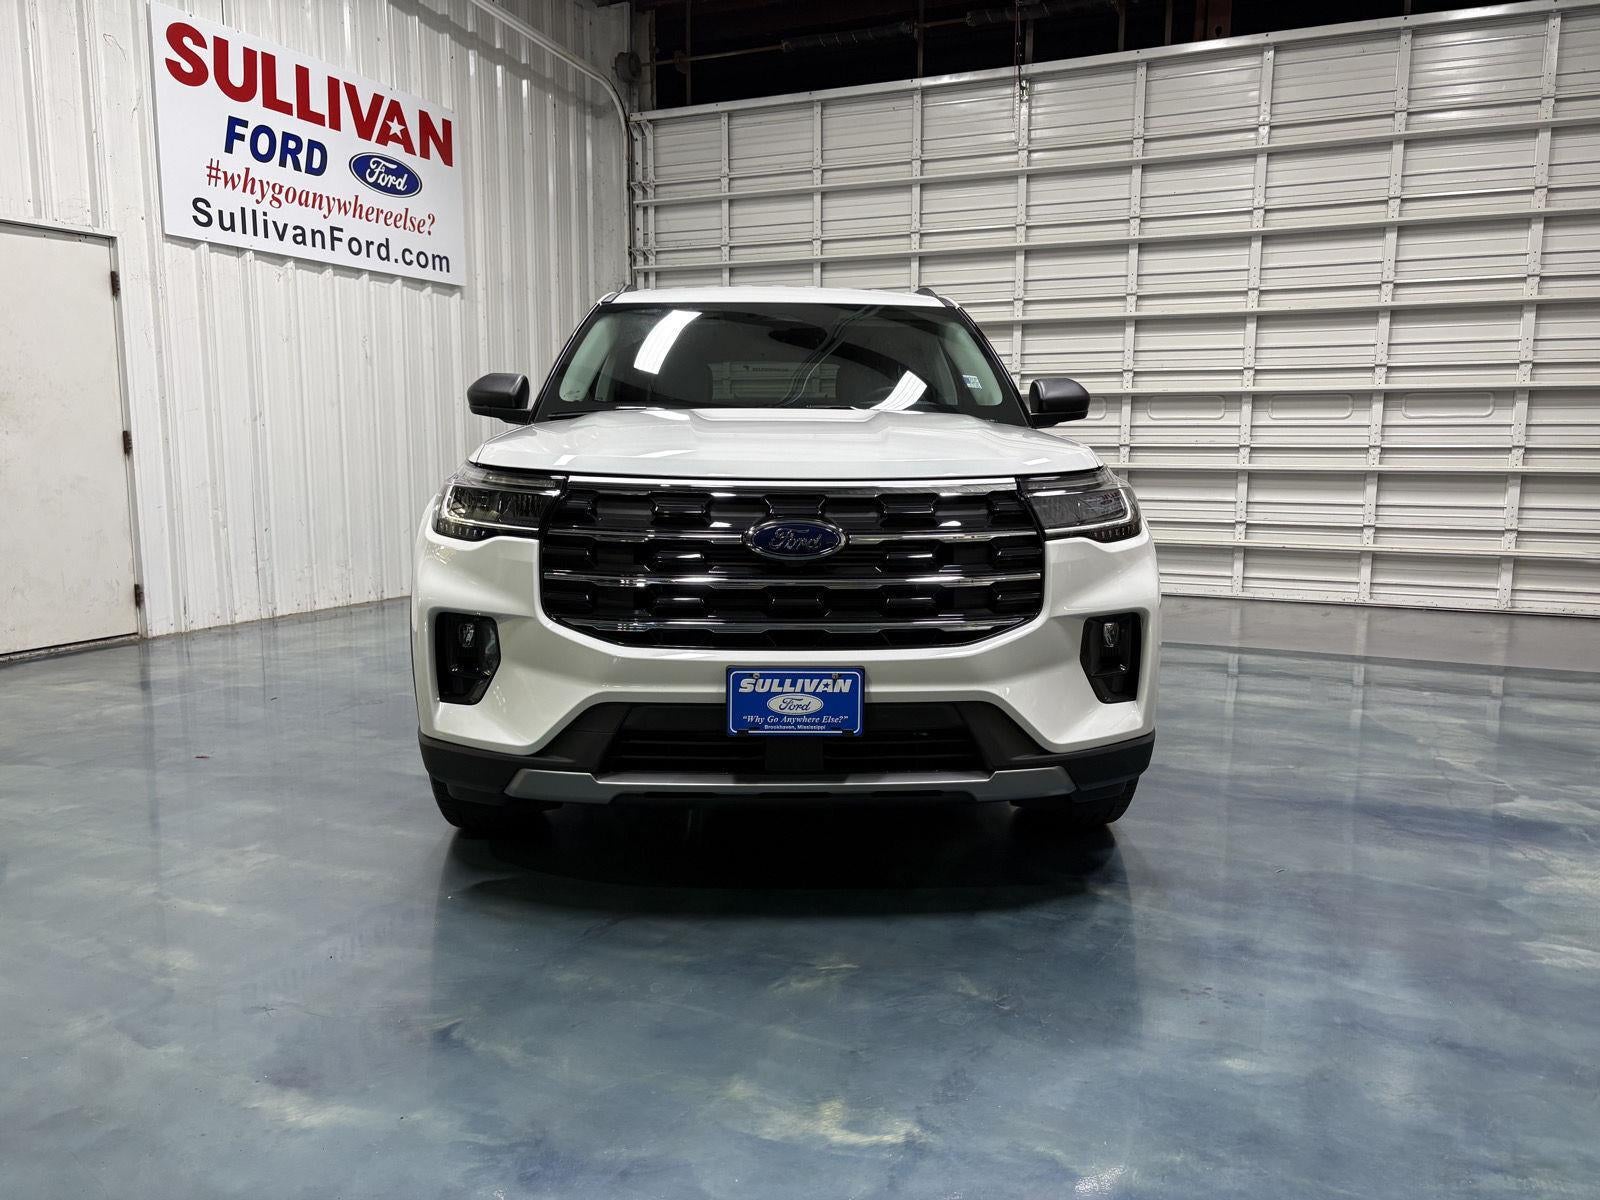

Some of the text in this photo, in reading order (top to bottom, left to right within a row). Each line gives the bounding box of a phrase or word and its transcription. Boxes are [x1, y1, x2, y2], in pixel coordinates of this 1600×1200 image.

[165, 22, 453, 168] SULLIVAN
[224, 115, 328, 177] FORD
[365, 157, 407, 192] Ford
[206, 158, 436, 236] #whygoanywhereelse?
[192, 197, 451, 273] SullivanFord.com
[769, 528, 822, 550] Ford
[739, 679, 852, 693] SULLIVAN
[767, 715, 779, 723] Go
[781, 715, 820, 725] Anywhere
[779, 698, 811, 711] Ford
